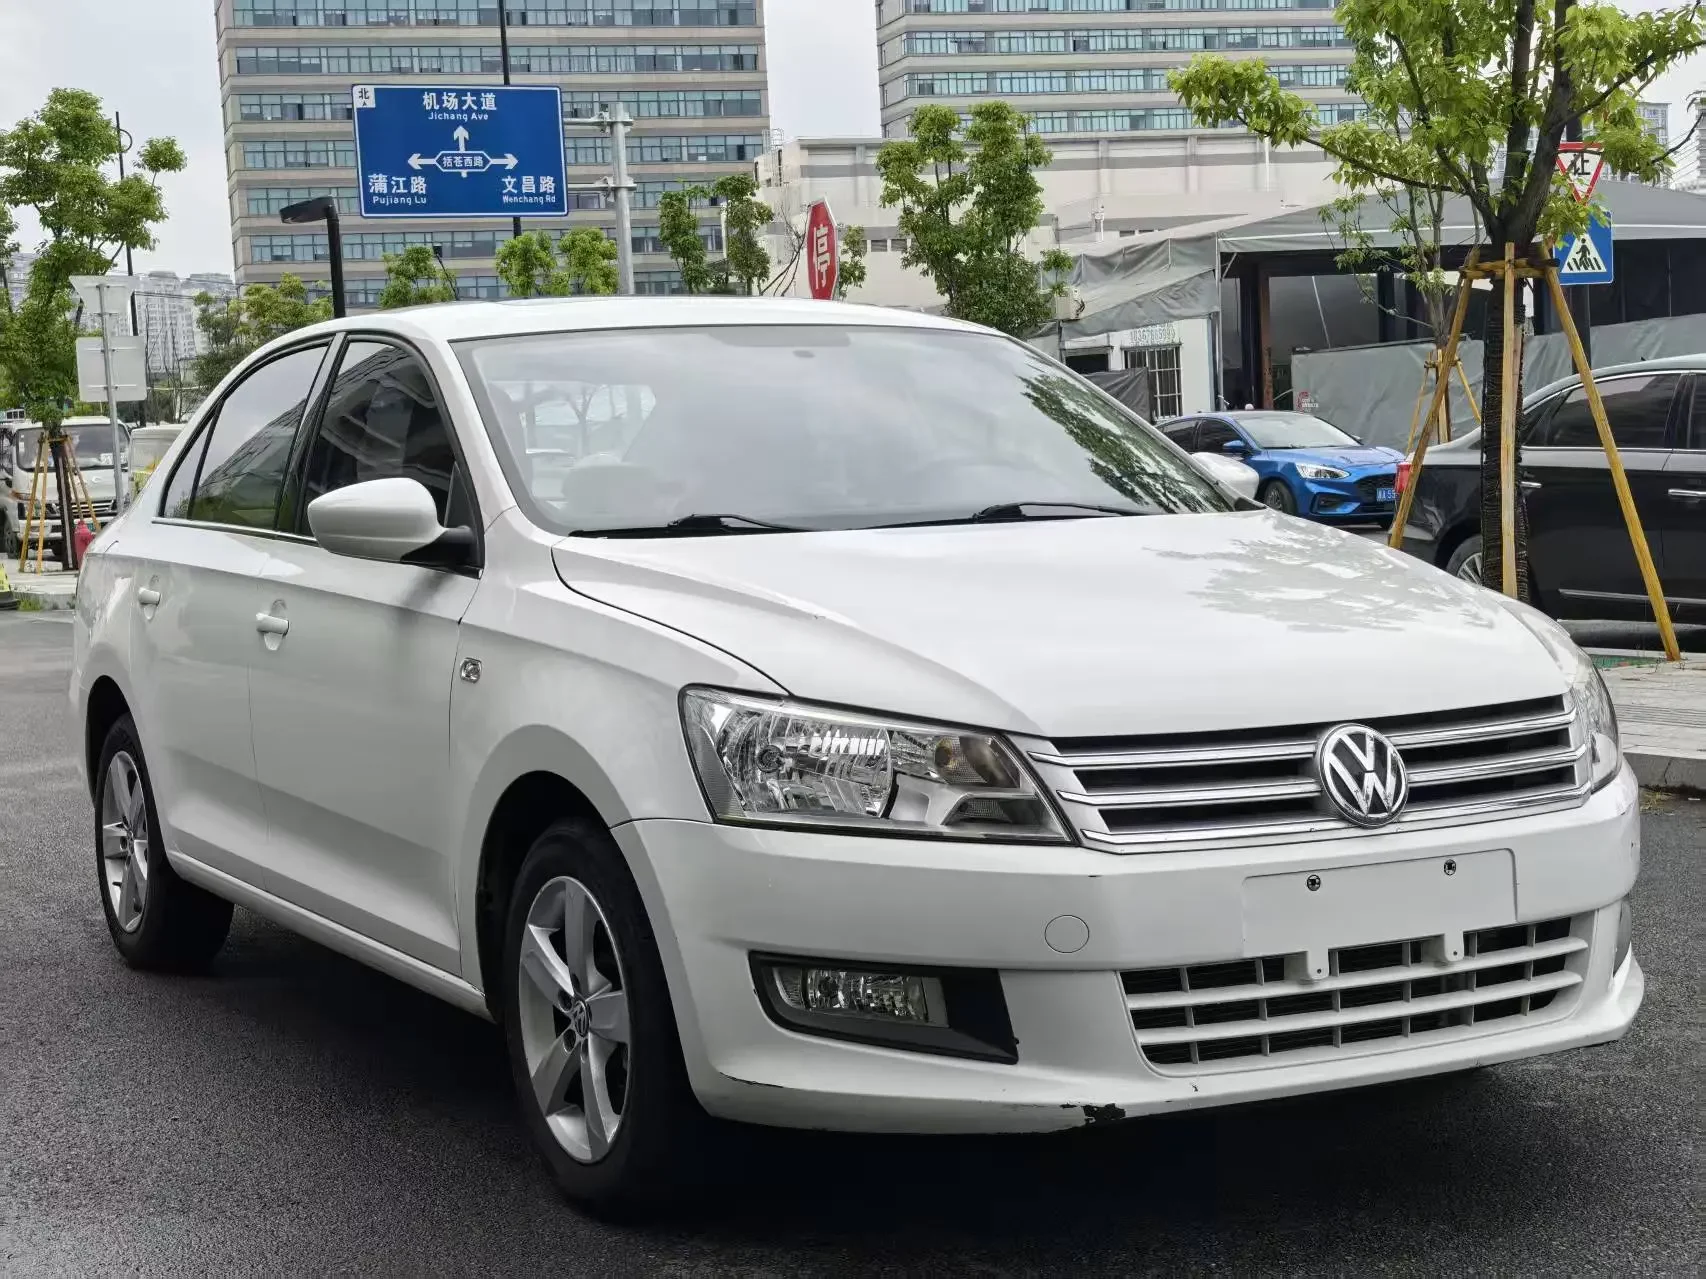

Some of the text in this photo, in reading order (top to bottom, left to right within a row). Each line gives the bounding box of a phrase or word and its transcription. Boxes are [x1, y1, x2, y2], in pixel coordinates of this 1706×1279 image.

[358, 87, 370, 100] 北
[422, 91, 497, 111] 机场大道
[428, 112, 489, 122] Jichang Ave
[442, 155, 484, 168] 括苍西路
[368, 173, 427, 194] 蒲江路
[501, 175, 556, 194] 文昌路
[372, 195, 427, 206] Pujiang Lu
[502, 195, 556, 205] Wenchang Rd
[813, 223, 832, 290] 停
